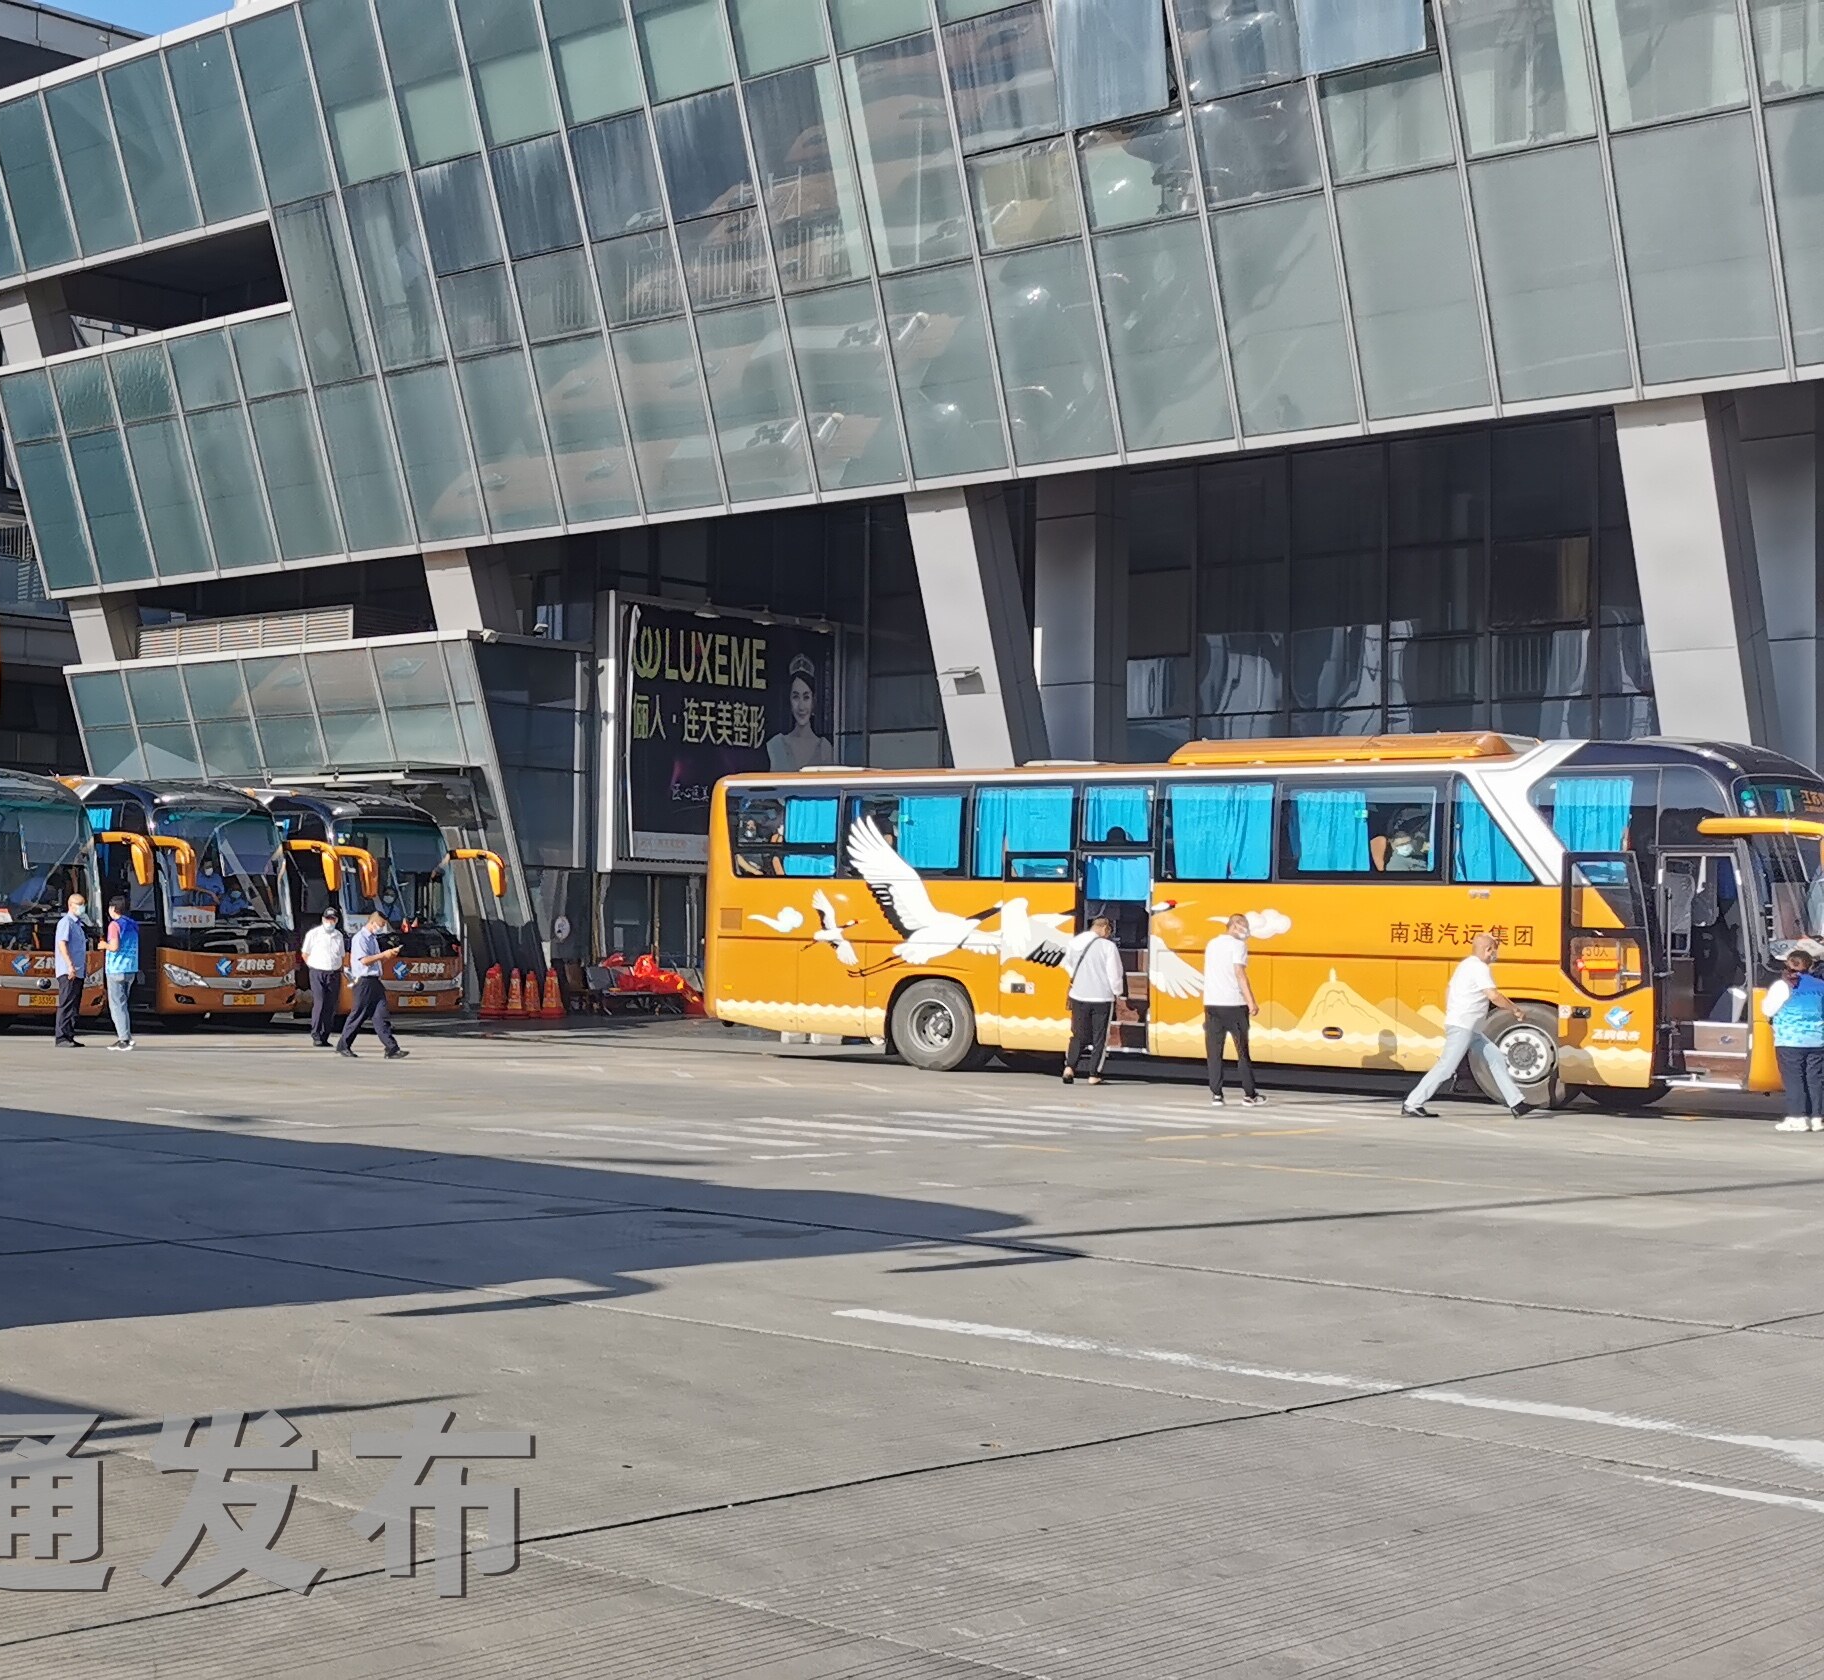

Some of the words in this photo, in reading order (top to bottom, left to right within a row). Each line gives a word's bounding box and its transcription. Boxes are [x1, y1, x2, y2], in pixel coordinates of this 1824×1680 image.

[665, 627, 767, 690] LUXEME
[1390, 922, 1534, 947] 南通汽运集团
